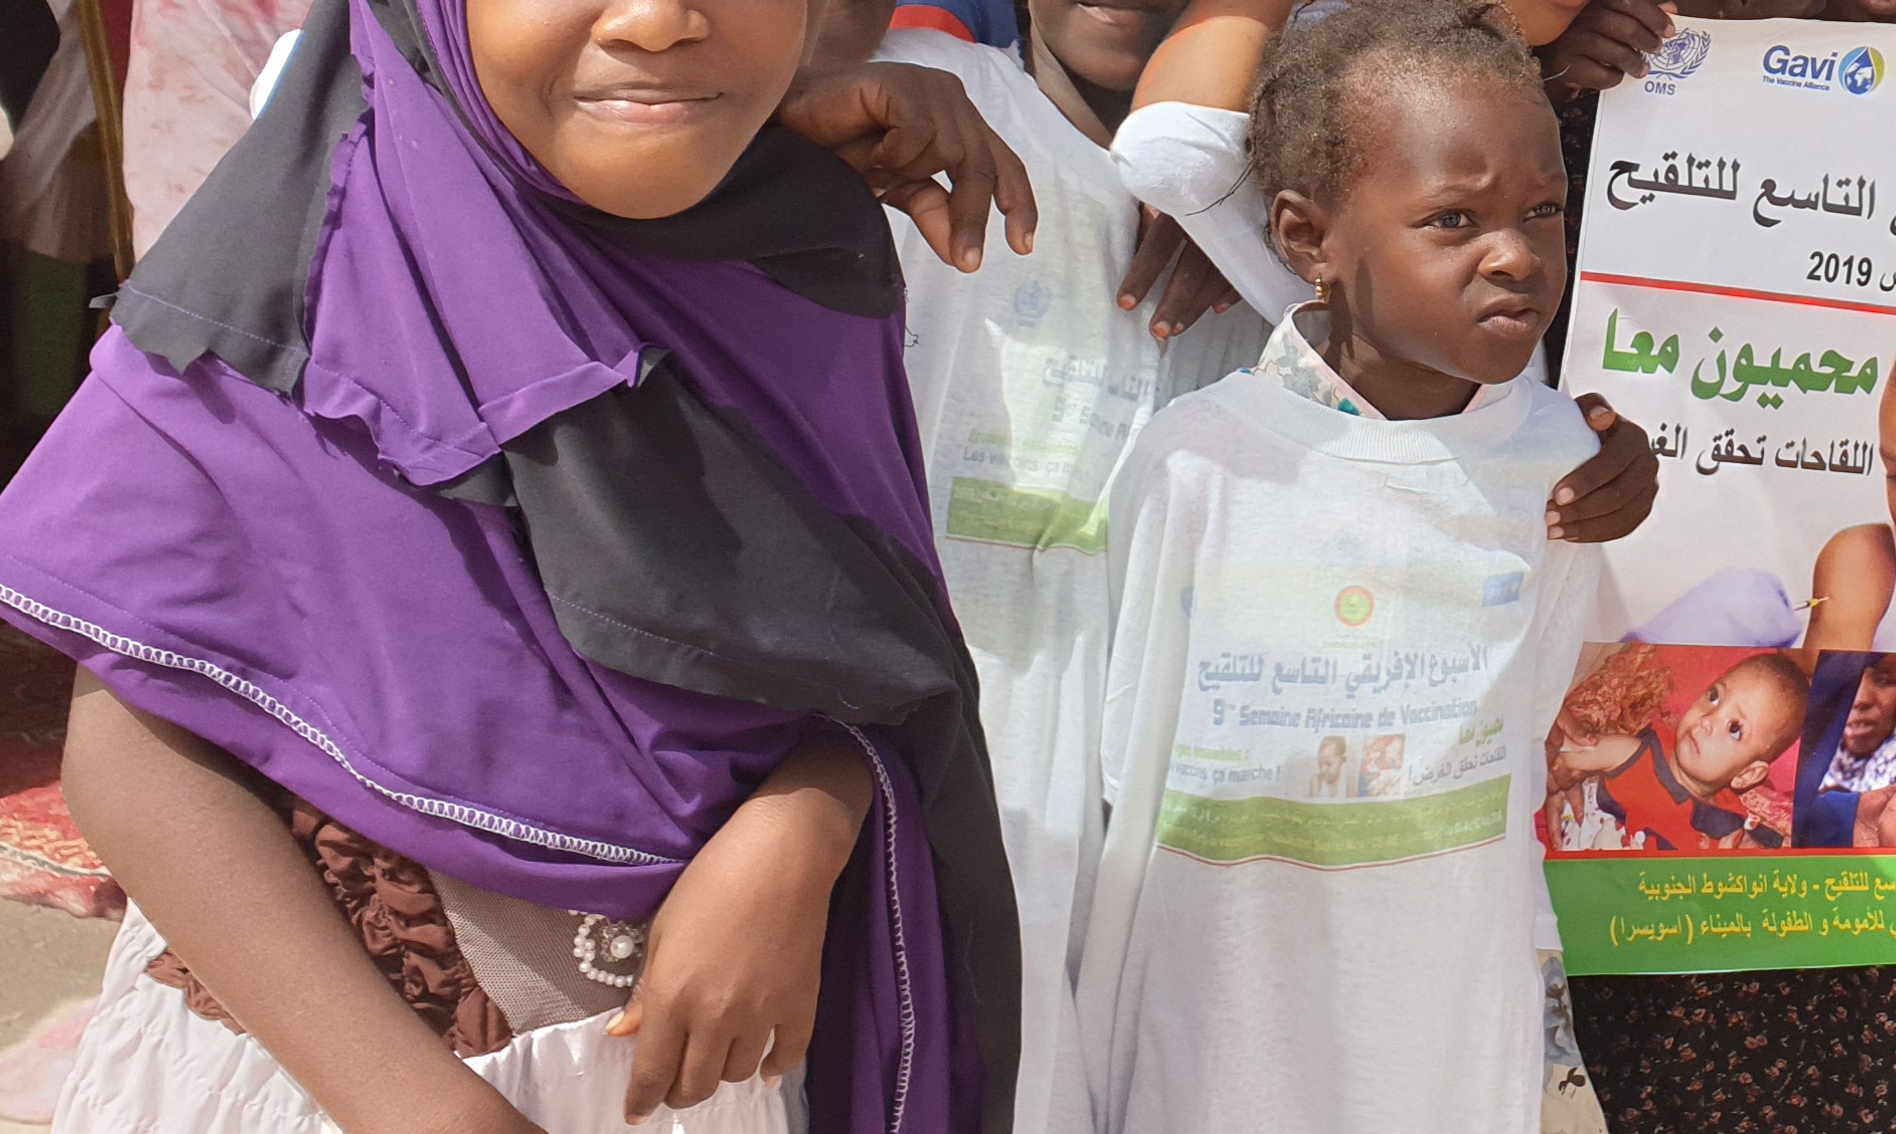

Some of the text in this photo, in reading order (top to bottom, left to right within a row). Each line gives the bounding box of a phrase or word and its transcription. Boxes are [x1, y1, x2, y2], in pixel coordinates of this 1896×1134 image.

[1762, 44, 1839, 82] Gavi
[1644, 80, 1676, 96] OMS
[1762, 75, 1830, 91] The Vaccine Alliance
[1606, 150, 1742, 211] للتلقيح
[1752, 173, 1877, 228] التاسع
[1806, 250, 1873, 287] 2019
[1602, 307, 1879, 410] محميون معا
[1695, 427, 1767, 476] تحقق
[1774, 436, 1875, 477] اللقاحات
[1197, 650, 1264, 693] للتلقيح
[1271, 656, 1338, 695] التاسع
[1239, 704, 1300, 728] Semaine
[1304, 706, 1372, 734] Africaine
[1377, 708, 1396, 728] de
[1399, 697, 1478, 726] Vaccination
[1228, 764, 1273, 783] marche
[1638, 870, 1697, 901] الجنوبية
[1772, 869, 1808, 900] ولاية
[1823, 870, 1870, 901] للتلقيح
[1699, 912, 1752, 939] بالميناء
[1761, 909, 1813, 937] الطفولة
[1819, 918, 1829, 937] و
